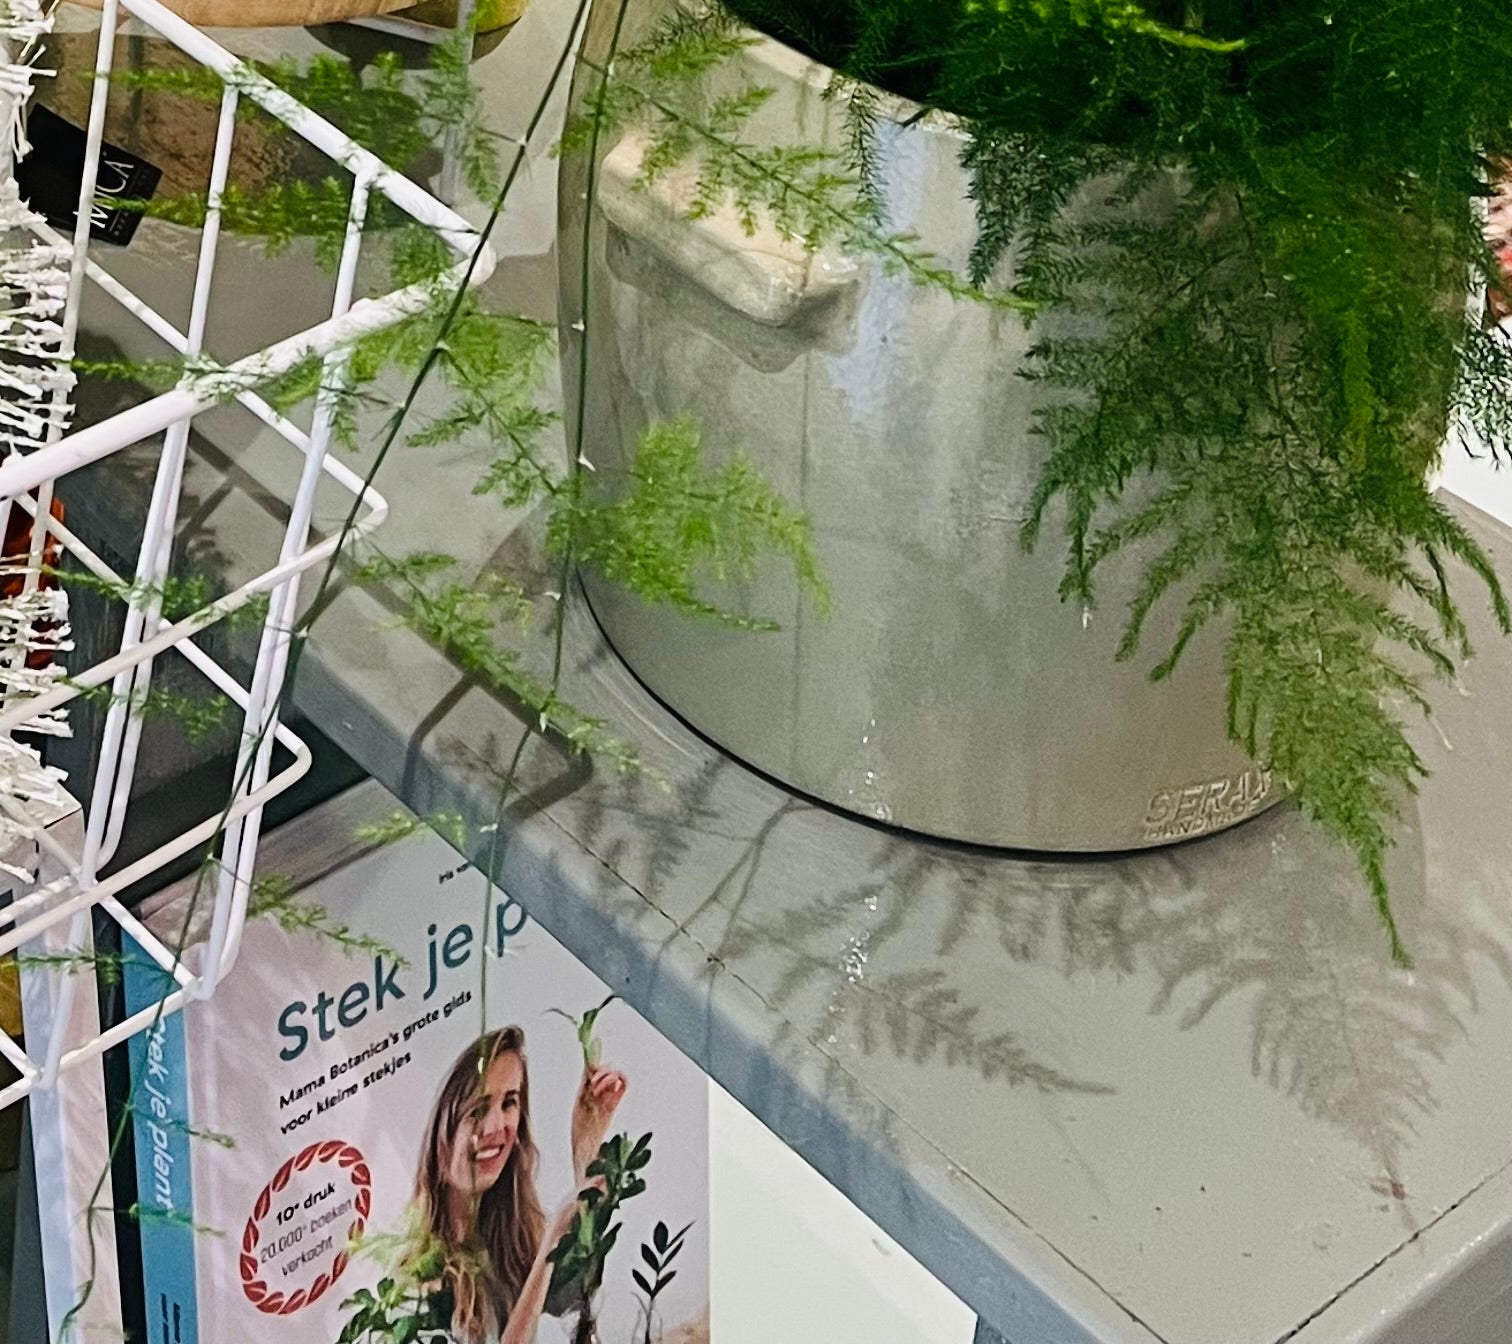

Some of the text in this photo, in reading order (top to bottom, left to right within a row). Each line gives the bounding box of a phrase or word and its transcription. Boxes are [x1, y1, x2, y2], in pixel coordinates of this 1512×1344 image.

[278, 955, 407, 1062] Stek
[423, 923, 473, 1001] je
[279, 989, 473, 1110] Mama Botanica's grote gids
[150, 1082, 172, 1121] je
[279, 1051, 412, 1135] voor kleine stekjes
[152, 1120, 176, 1211] plant
[303, 1181, 337, 1209] druk
[310, 1198, 353, 1234] boeken
[282, 1235, 334, 1278] verkocht
